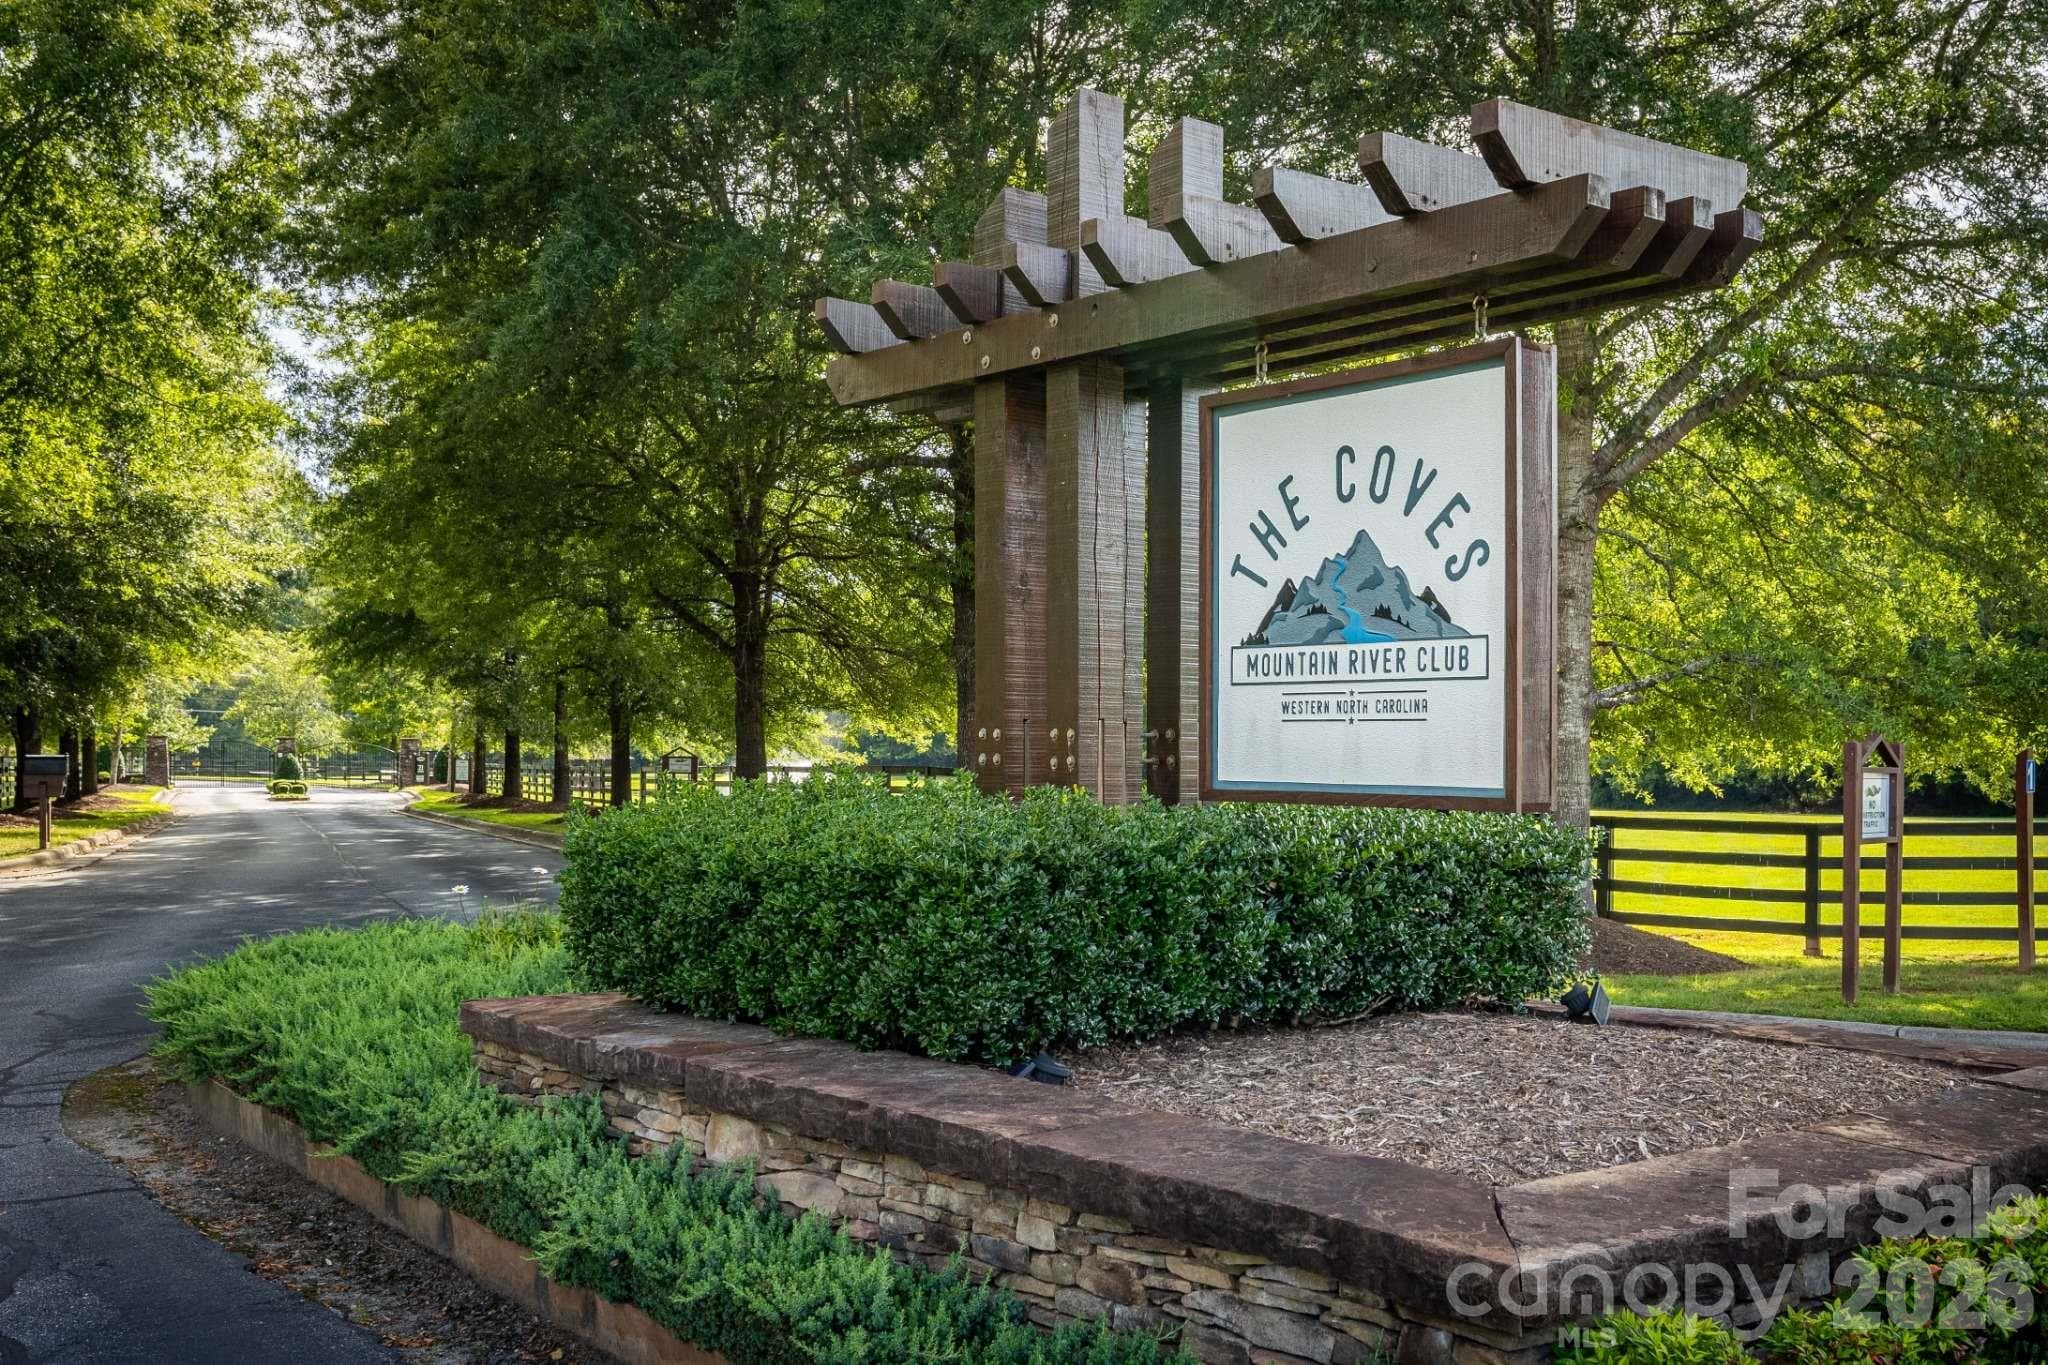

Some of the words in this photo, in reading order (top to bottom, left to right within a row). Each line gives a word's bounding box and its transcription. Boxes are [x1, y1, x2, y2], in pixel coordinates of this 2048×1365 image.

[1231, 475, 1310, 587] THE
[1335, 445, 1490, 581] COVES
[1246, 650, 1338, 678] MOUNTAIN
[1349, 647, 1406, 675] RIVER
[1417, 645, 1470, 672] CLUB
[1281, 699, 1330, 715] WESTERN
[1336, 699, 1368, 714] NORTH
[1375, 698, 1428, 713] CAROLINA
